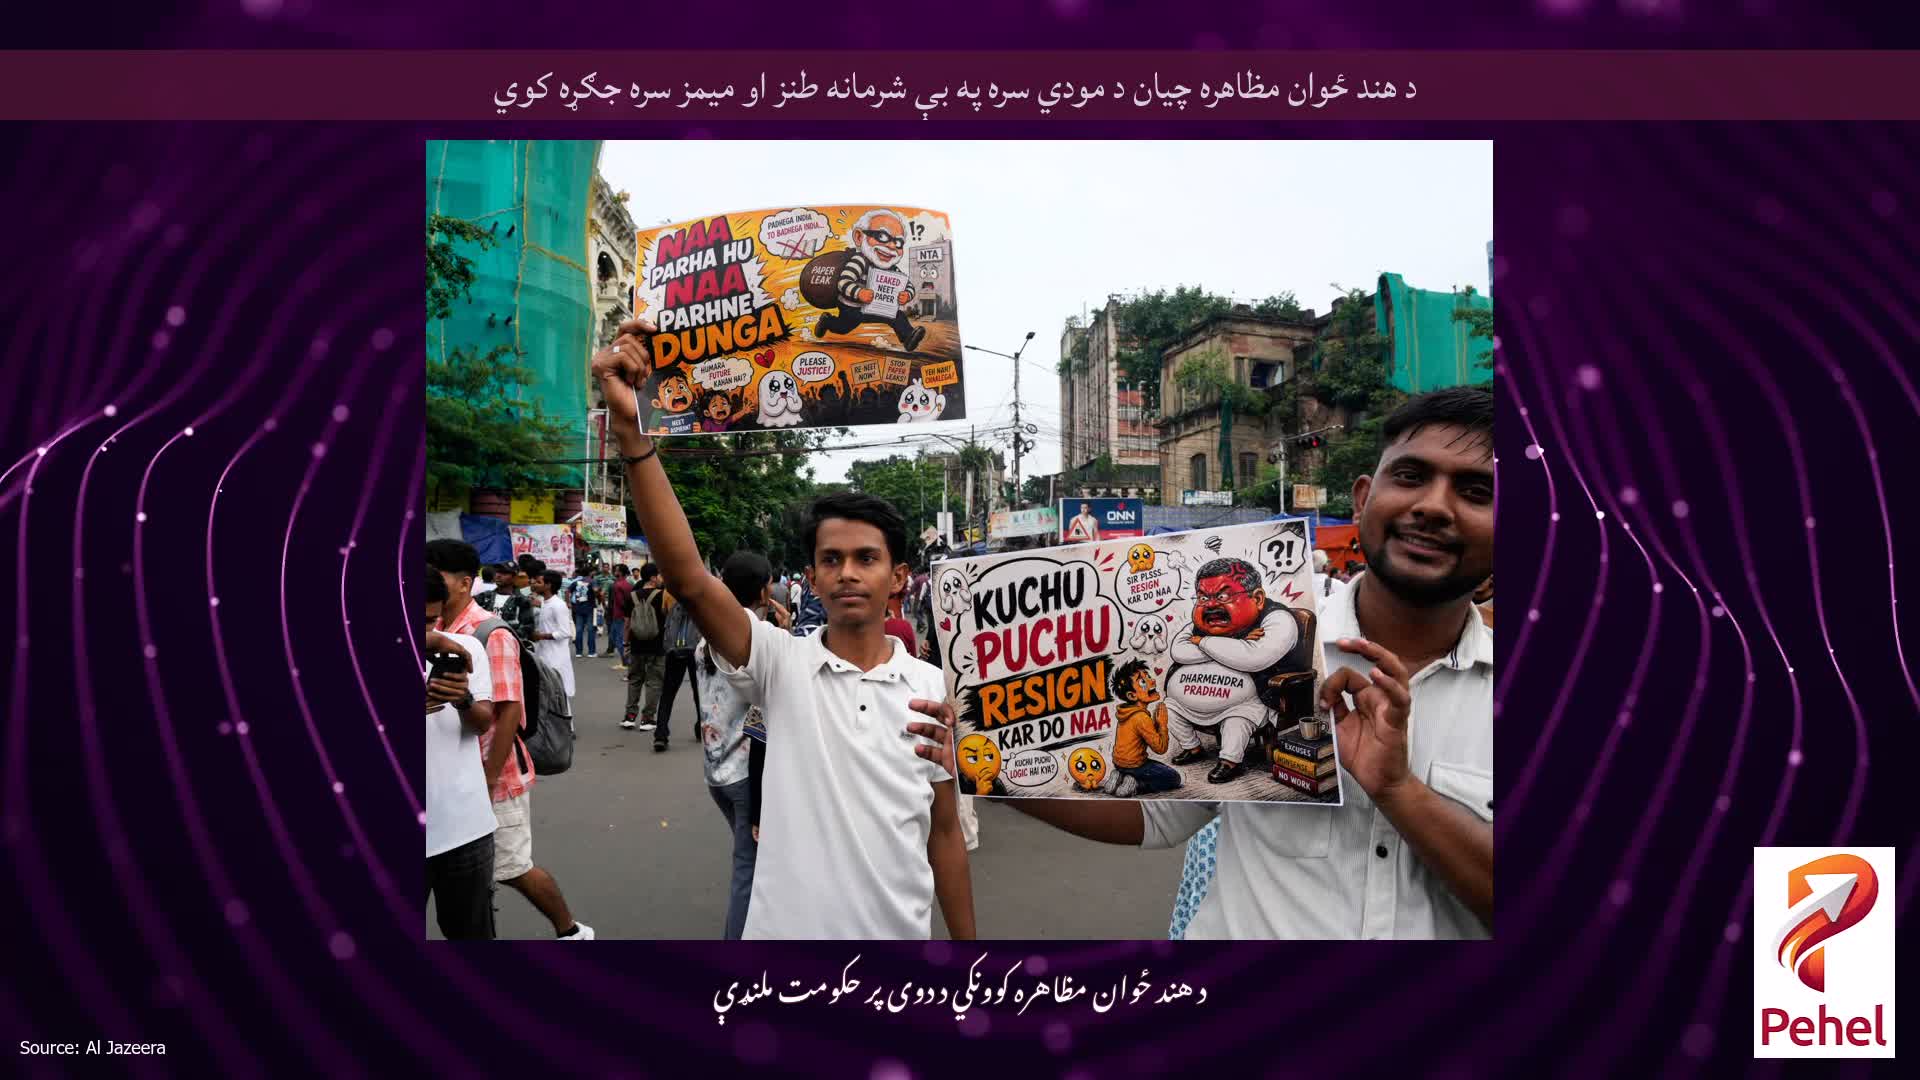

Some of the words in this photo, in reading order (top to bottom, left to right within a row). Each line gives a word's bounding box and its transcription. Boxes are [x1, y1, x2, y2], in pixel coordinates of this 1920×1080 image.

[768, 216, 794, 230] PADHEGA
[796, 213, 812, 223] INDIA
[767, 231, 776, 240] TO
[777, 225, 802, 237] BADHEGA
[656, 216, 731, 265] NAA
[919, 248, 939, 261] NTA
[651, 249, 718, 288] PARHA
[723, 238, 751, 264] HU
[811, 265, 836, 276] PAPER
[666, 263, 745, 308] NAA
[810, 275, 832, 285] LEAK
[875, 273, 901, 287] LEAKED
[877, 284, 895, 295] NEET
[874, 292, 895, 304] PAPER
[660, 293, 752, 332] PARHNE
[652, 306, 784, 369] DUNGA
[700, 361, 726, 374] HUMARA
[800, 356, 827, 366] PLEASE
[890, 360, 906, 368] STOP
[709, 368, 732, 381] FUTURE
[798, 365, 831, 376] JUSTICE!
[1106, 510, 1136, 521] ONN
[1127, 574, 1139, 585] SIR
[1130, 578, 1160, 594] RESIGN
[973, 567, 1085, 631] KUCHU
[1127, 594, 1142, 605] KAR
[1143, 591, 1154, 600] DO
[1155, 585, 1172, 597] NAA
[972, 604, 1110, 681] PUCHU
[1179, 673, 1244, 689] DHARMENDRA
[978, 661, 1107, 728] RESIGN
[1183, 684, 1231, 699] PRADHAN
[998, 723, 1035, 751] KAR
[1039, 716, 1065, 743] DO
[1070, 706, 1111, 736] NAA
[1284, 742, 1312, 757] EXCUSES
[1014, 757, 1033, 768] KUCHU
[1010, 767, 1028, 779] LOGIC
[1029, 766, 1040, 776] HAI
[1041, 764, 1056, 775] KYA?
[1278, 770, 1289, 781] NO
[1290, 775, 1311, 790] WORK
